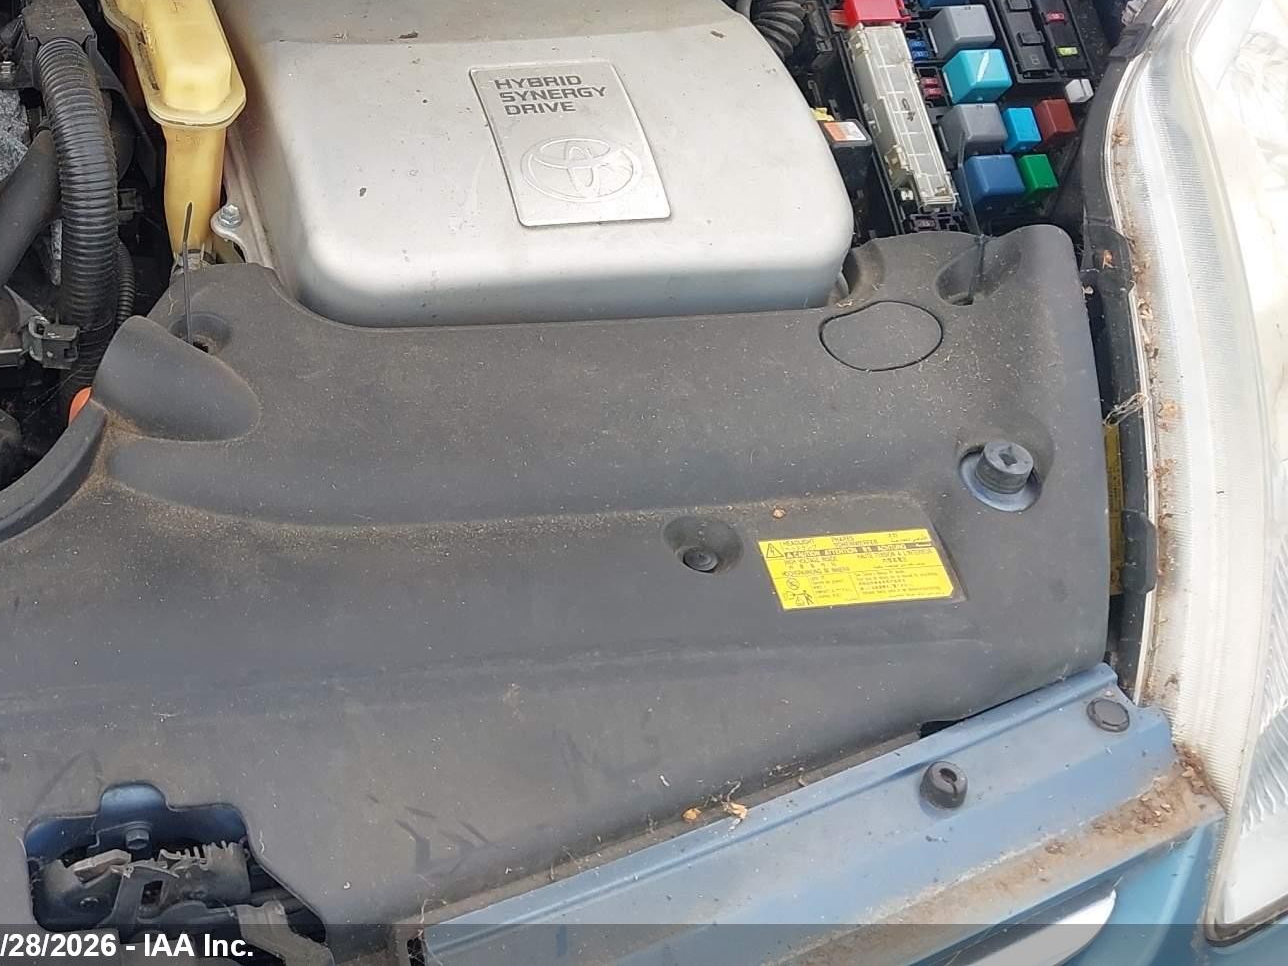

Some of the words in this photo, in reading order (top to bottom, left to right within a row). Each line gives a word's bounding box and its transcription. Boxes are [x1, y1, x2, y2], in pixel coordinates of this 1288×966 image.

[494, 75, 582, 90] HYBRID
[500, 86, 609, 103] SYNERGY
[504, 101, 576, 116] DRIVE
